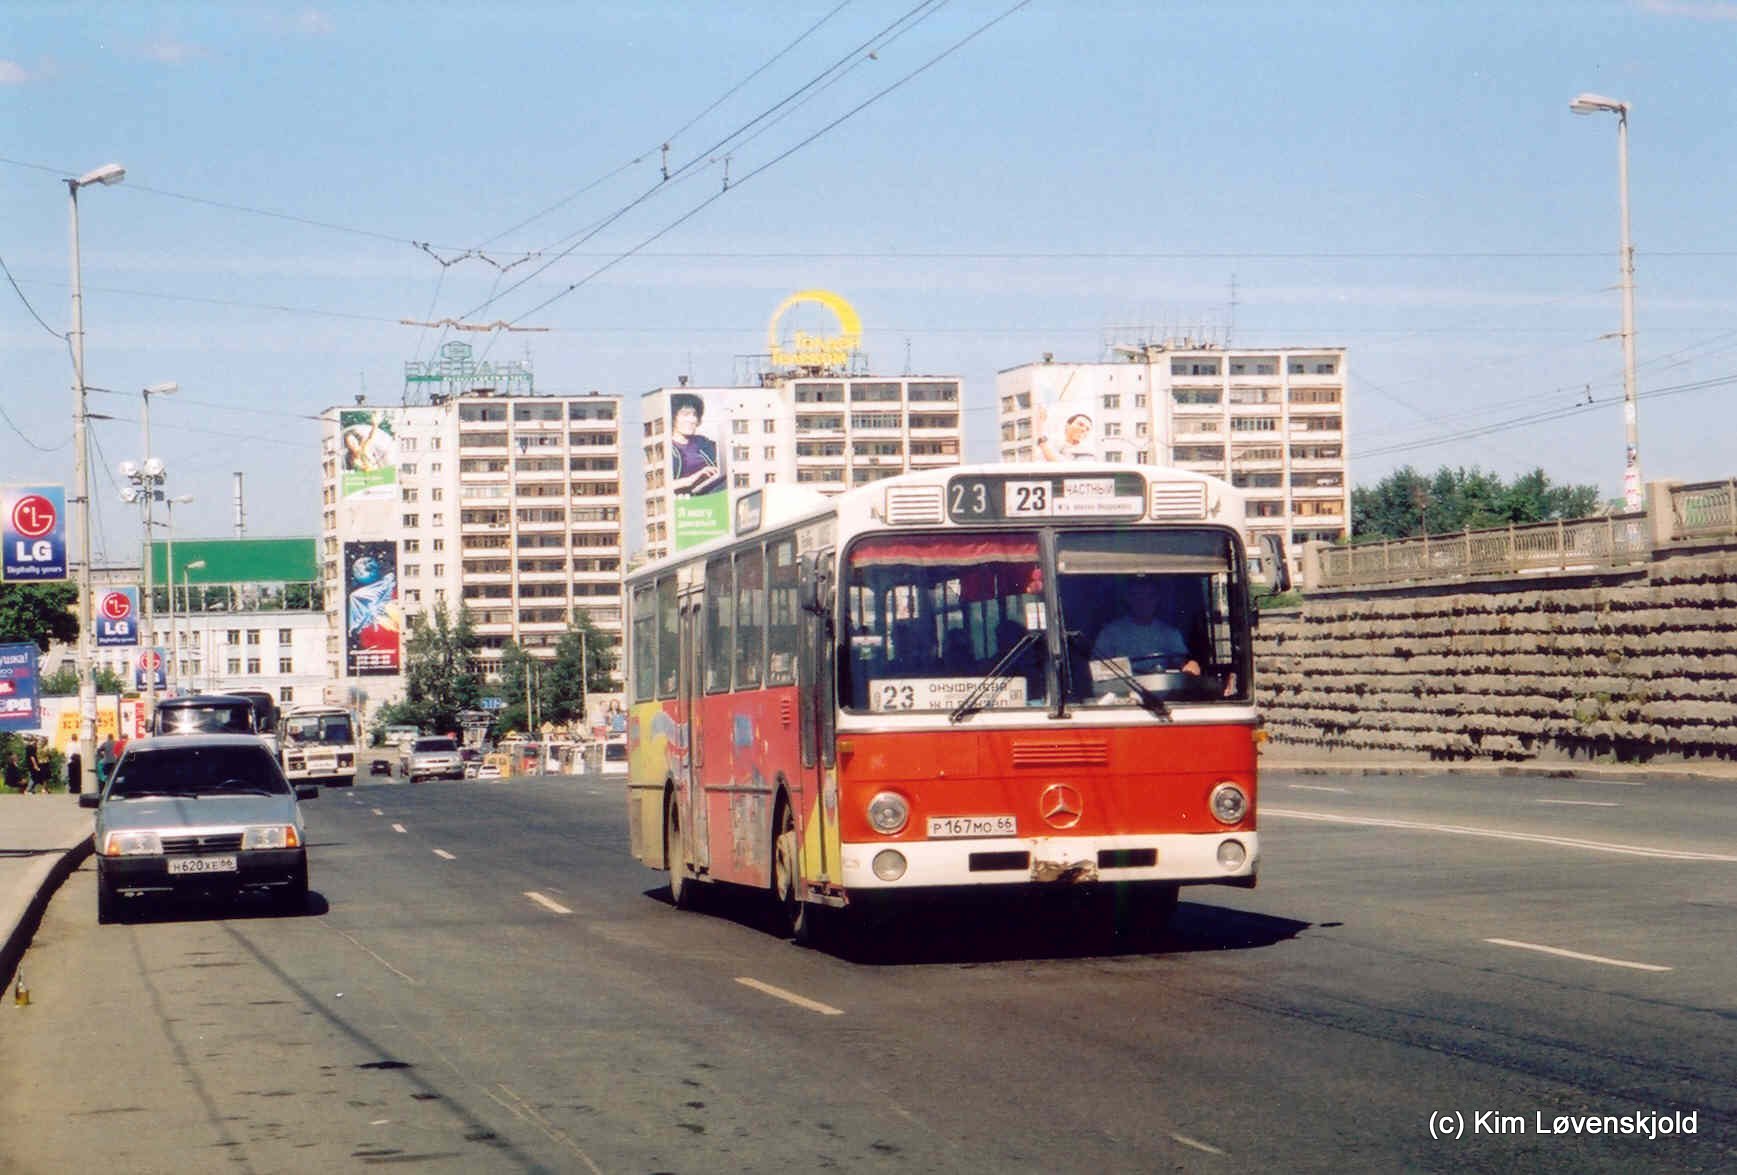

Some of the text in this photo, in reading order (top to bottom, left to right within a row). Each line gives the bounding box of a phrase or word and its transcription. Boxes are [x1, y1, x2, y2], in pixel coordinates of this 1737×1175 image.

[952, 484, 986, 513] 23
[1016, 487, 1045, 511] 23
[16, 540, 53, 562] LG
[104, 621, 130, 636] LG
[883, 685, 915, 709] 23
